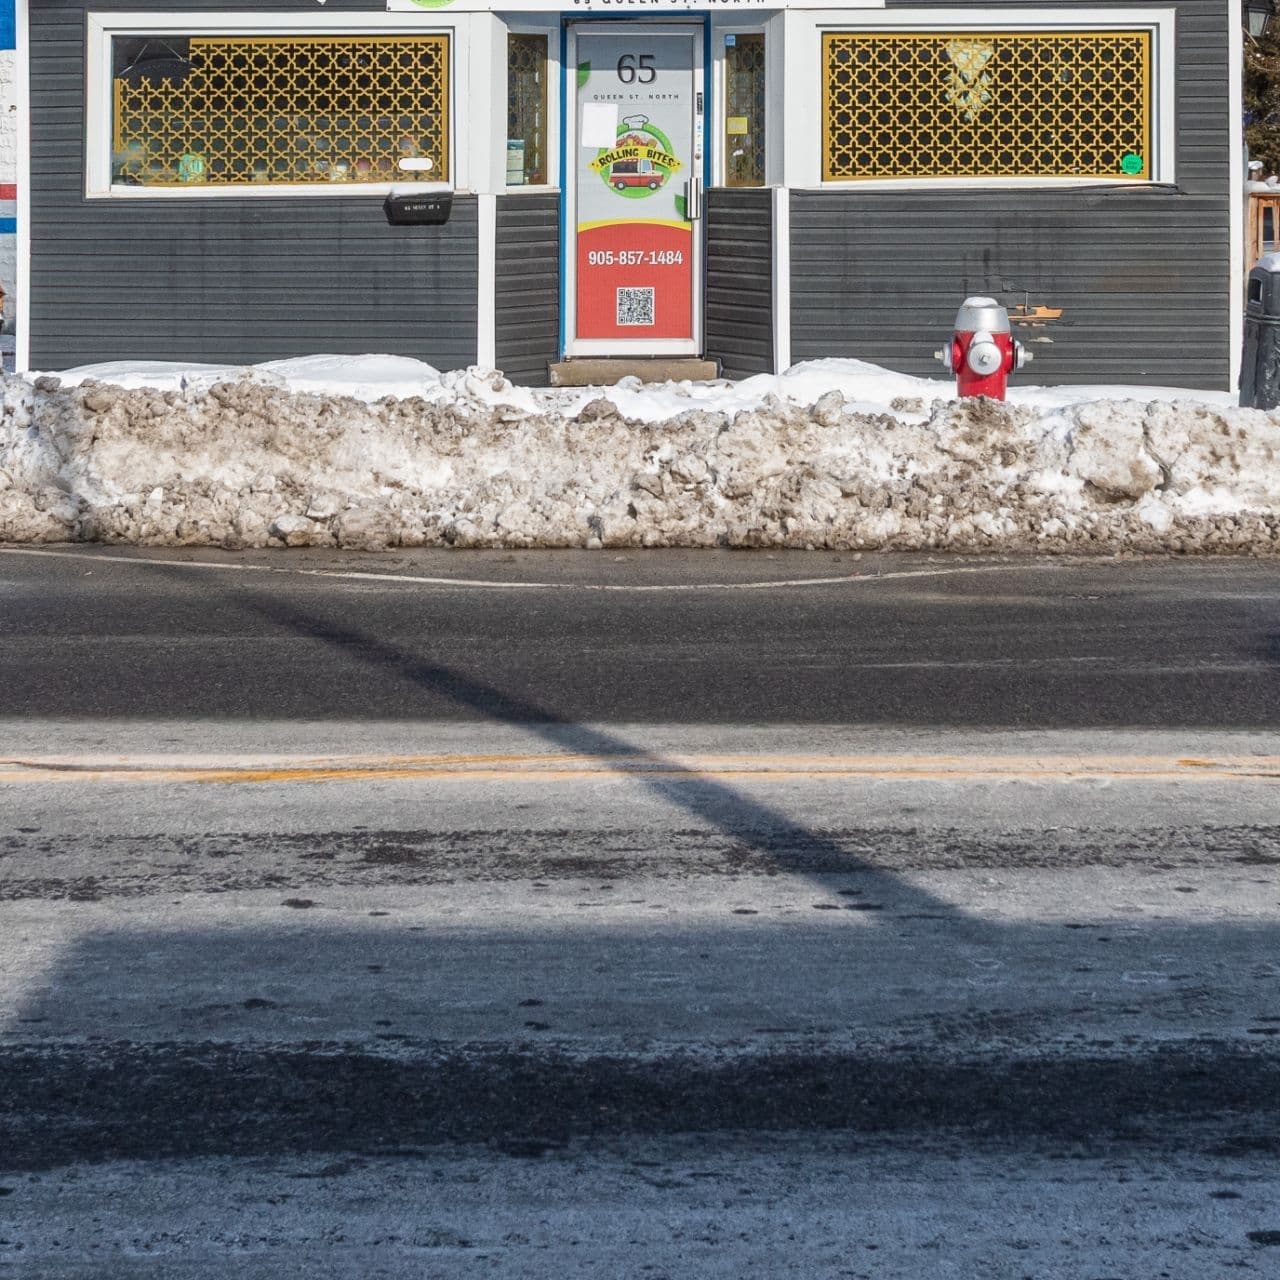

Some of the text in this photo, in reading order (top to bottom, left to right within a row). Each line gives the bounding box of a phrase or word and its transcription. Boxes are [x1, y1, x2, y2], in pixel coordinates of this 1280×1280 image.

[617, 54, 656, 84] 65
[598, 148, 675, 168] ROLLING BITES
[588, 250, 683, 266] 905-857-1484
